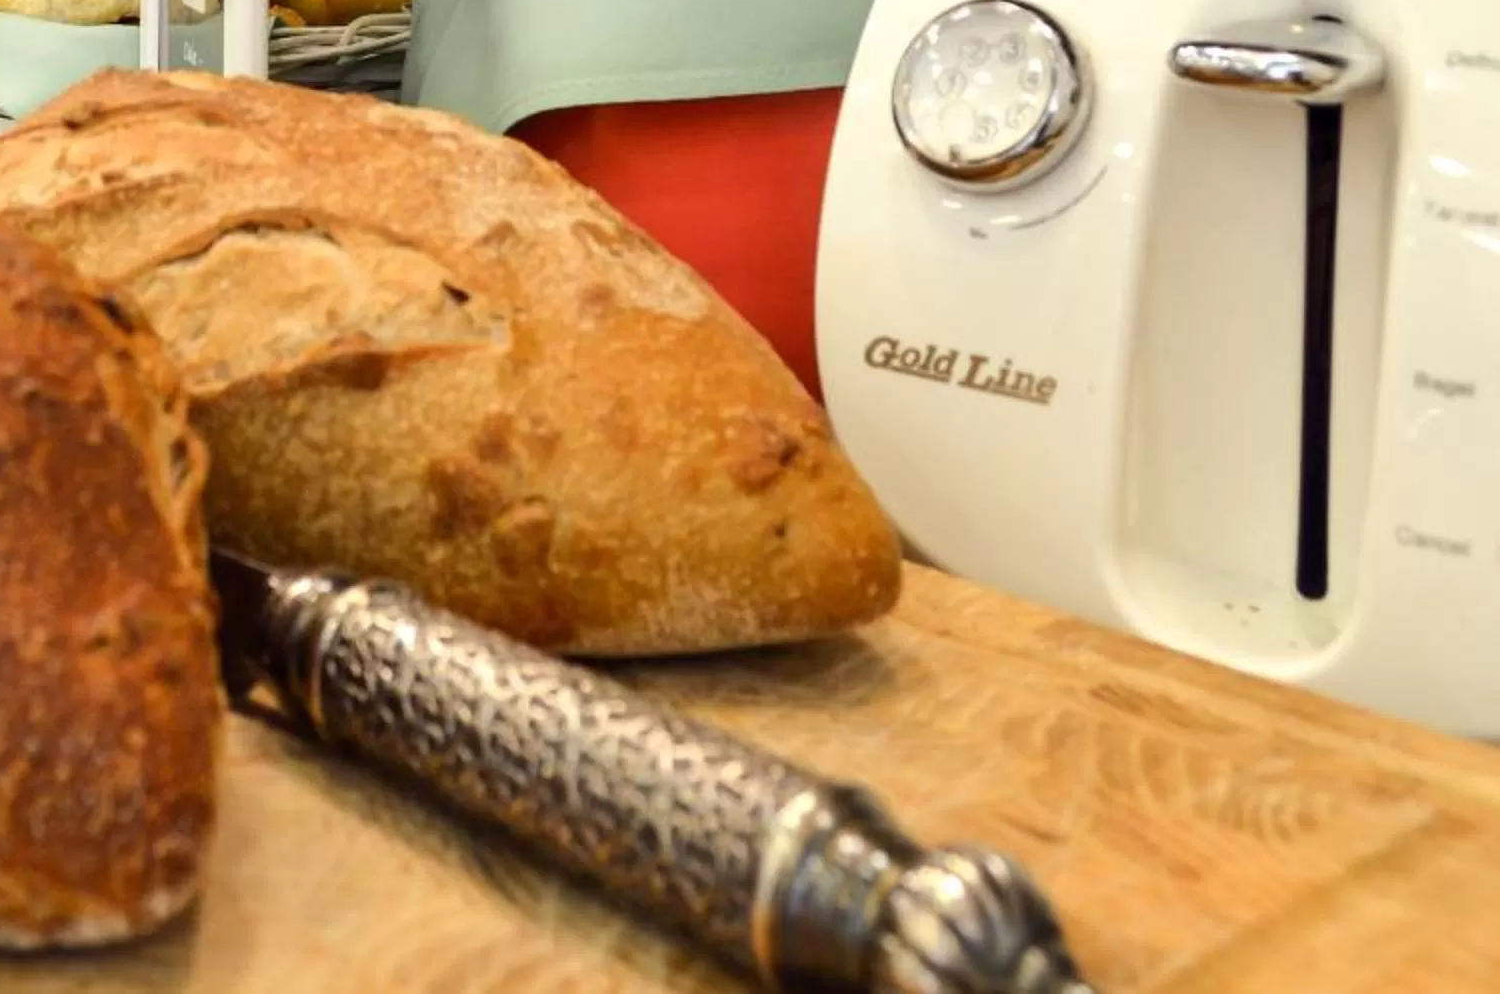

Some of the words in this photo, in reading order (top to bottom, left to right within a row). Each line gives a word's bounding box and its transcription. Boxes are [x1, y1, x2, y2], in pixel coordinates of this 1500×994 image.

[864, 335, 959, 384] Gold
[956, 353, 1058, 405] Line
[1393, 522, 1471, 557] Cancel
